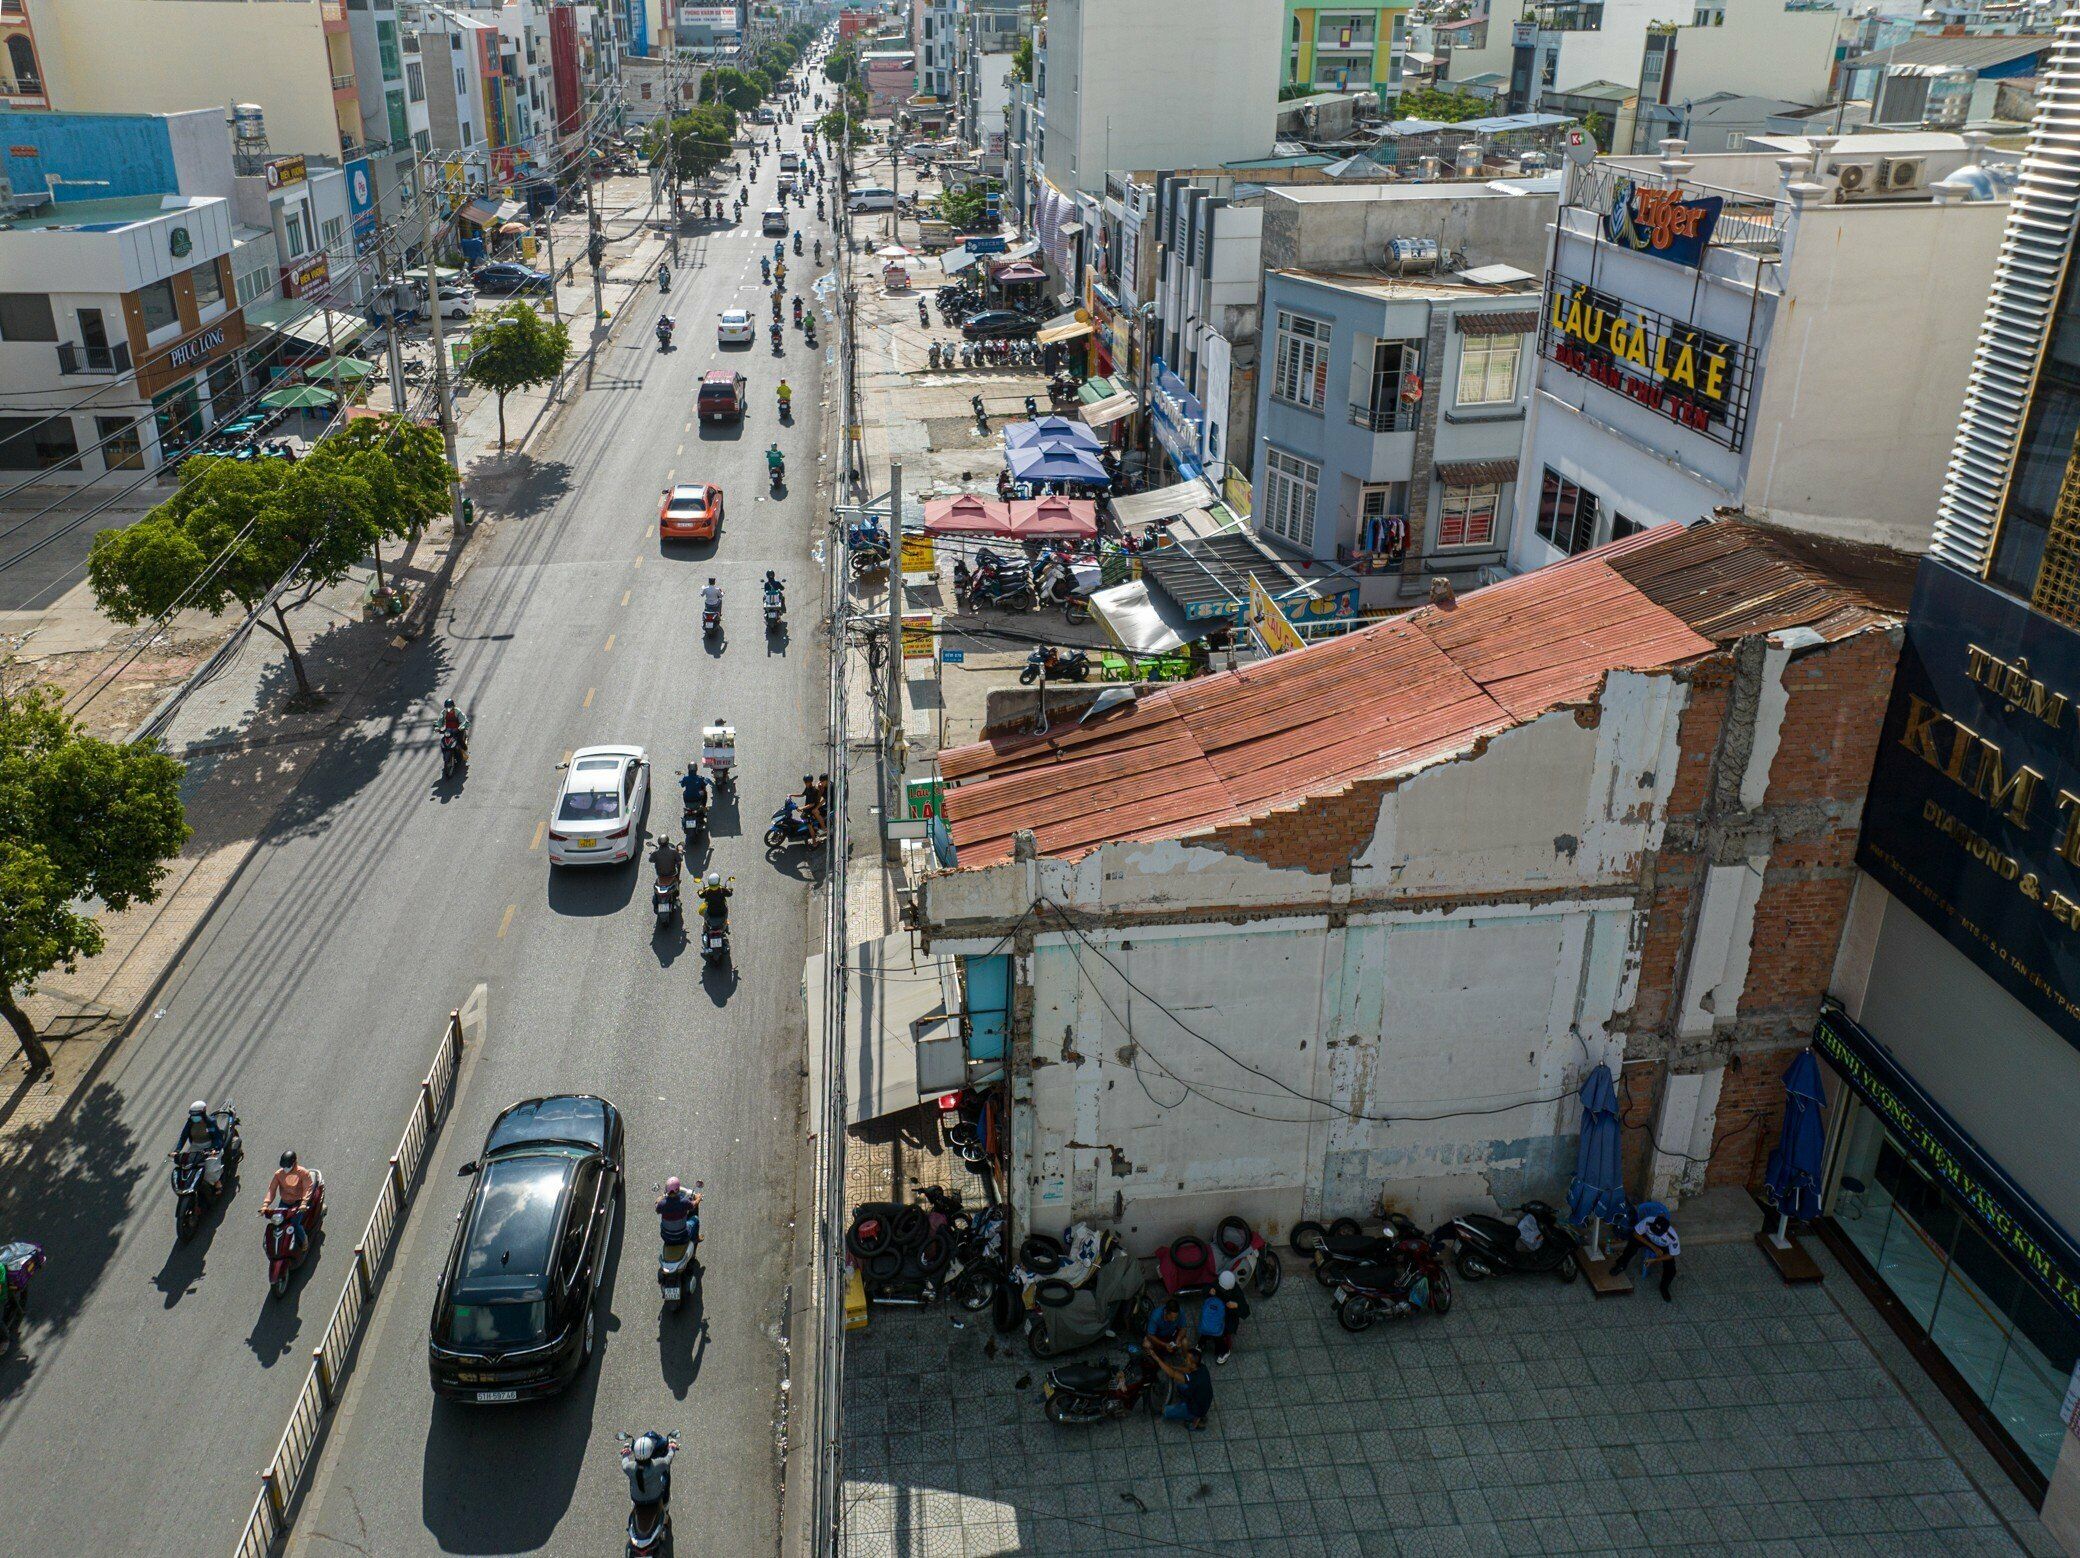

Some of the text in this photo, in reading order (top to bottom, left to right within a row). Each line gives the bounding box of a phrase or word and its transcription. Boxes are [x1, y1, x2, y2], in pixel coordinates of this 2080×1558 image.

[1635, 186, 1708, 249] Tiger
[199, 327, 225, 354] LONG
[1552, 285, 1727, 400] LẨU GÀ LÁ É
[1626, 376, 1666, 410] PHÚ
[1670, 395, 1710, 431] YÊN
[1966, 643, 2068, 729] TIỆM
[1898, 692, 2044, 831] KIM
[1923, 799, 2020, 881] DIAMOND
[2019, 872, 2041, 900] &
[2012, 1231, 2052, 1278] KIM
